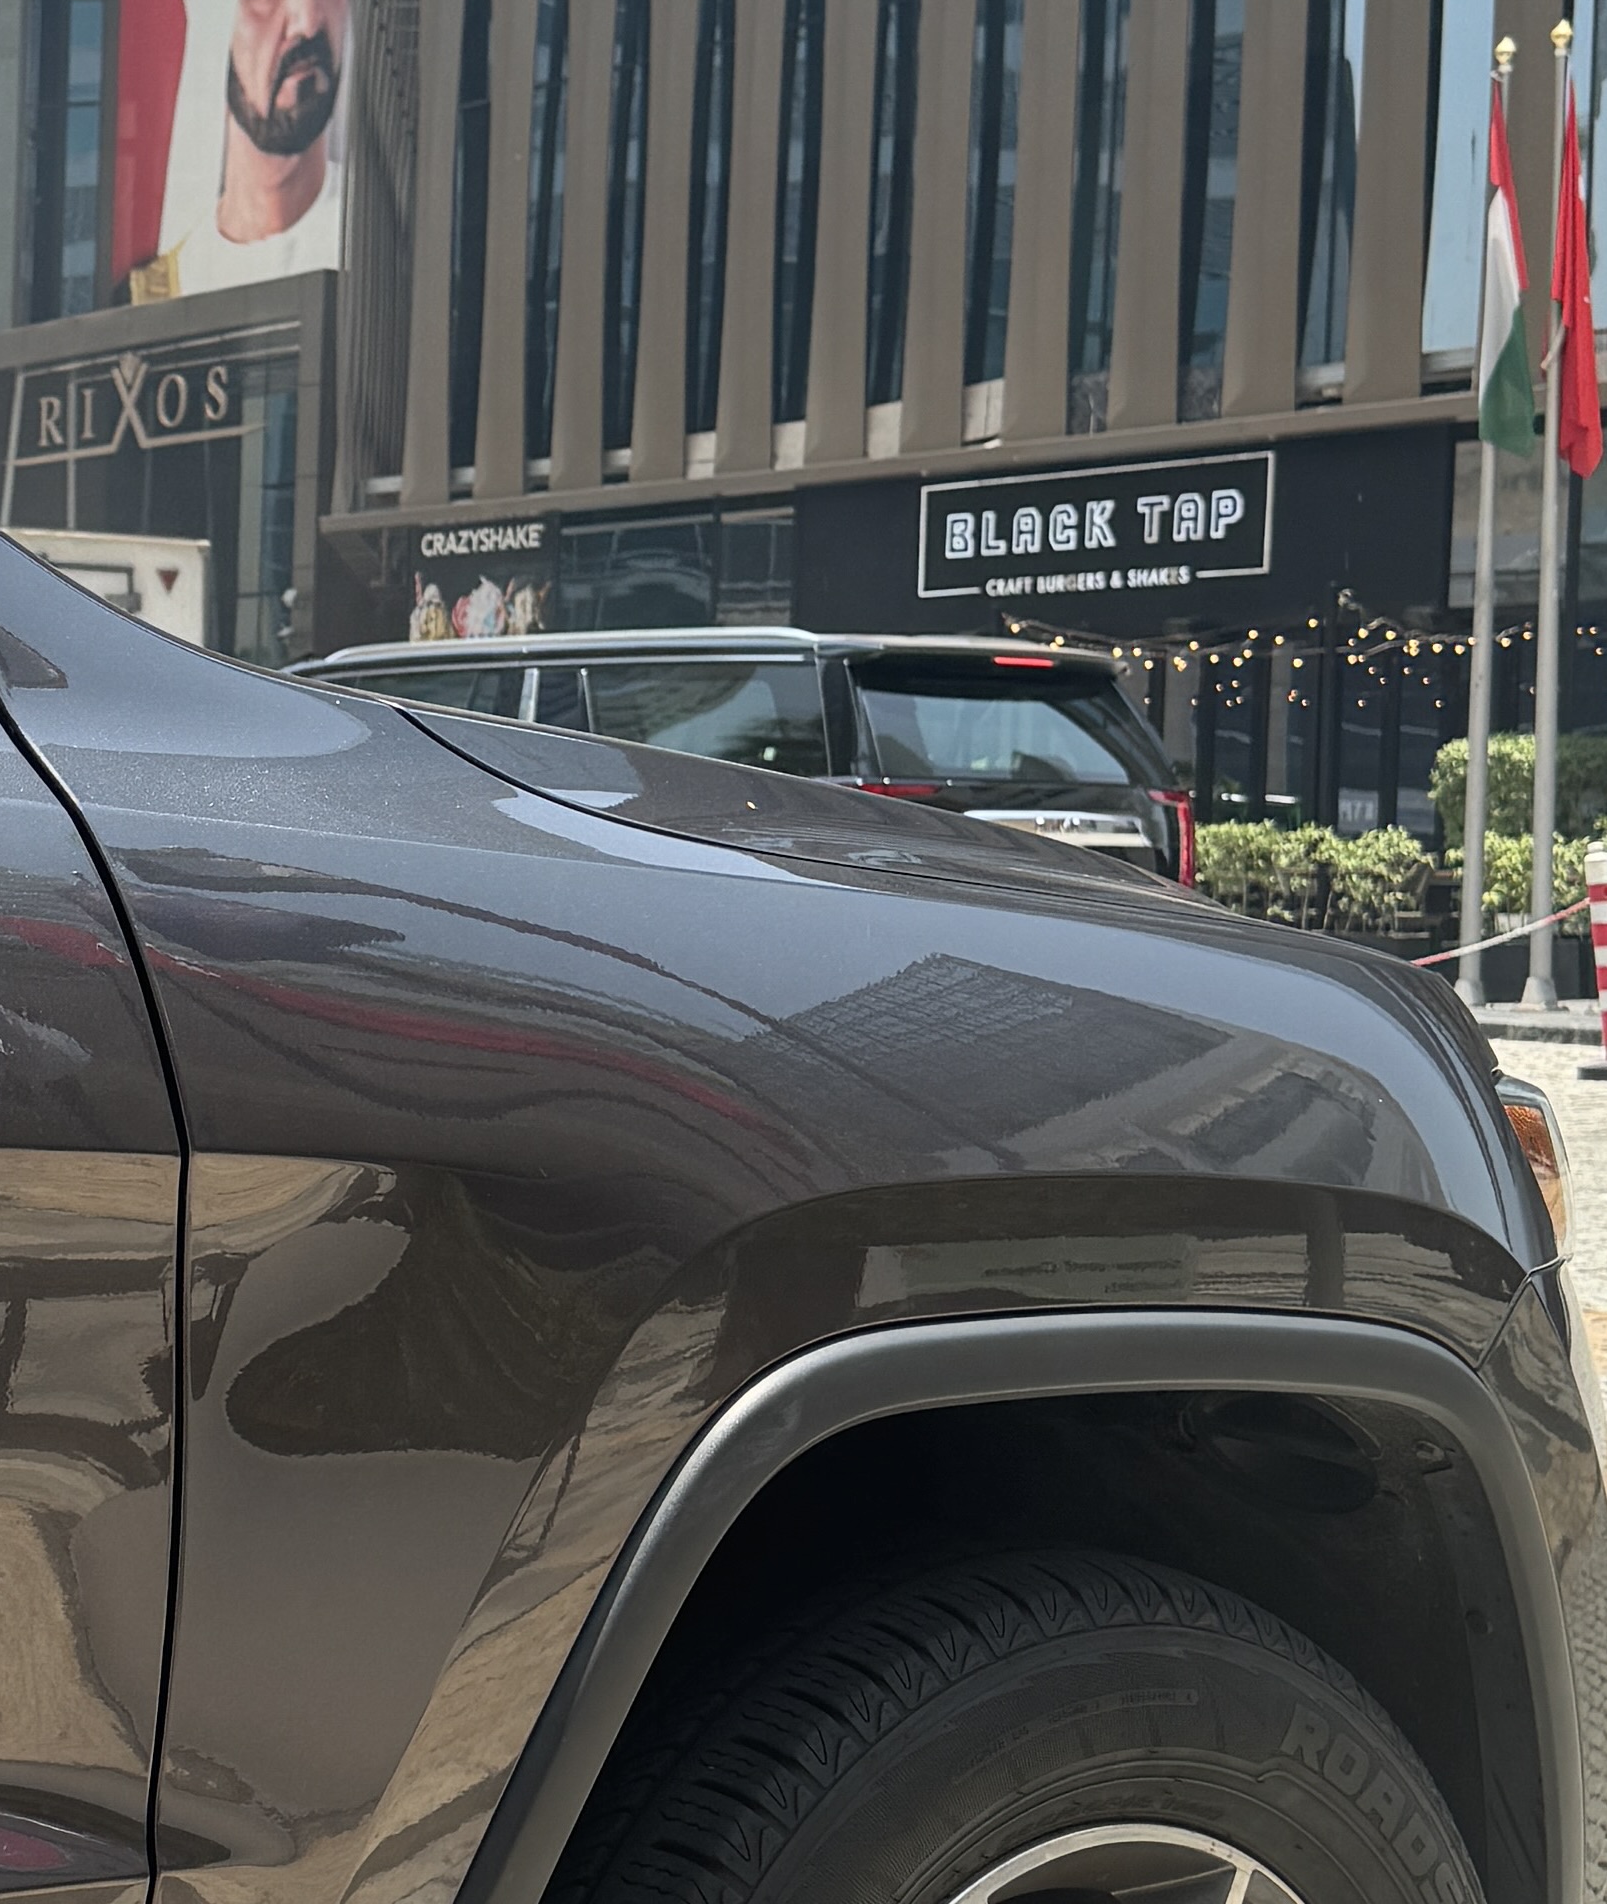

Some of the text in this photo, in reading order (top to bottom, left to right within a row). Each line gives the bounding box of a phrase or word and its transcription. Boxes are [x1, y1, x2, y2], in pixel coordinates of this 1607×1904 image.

[38, 360, 228, 449] RIXOS
[420, 523, 543, 558] CRAZYSHAKE
[944, 488, 1245, 560] BLACK TAP
[985, 565, 1191, 597] CRAFT BURGERS & SHAKES
